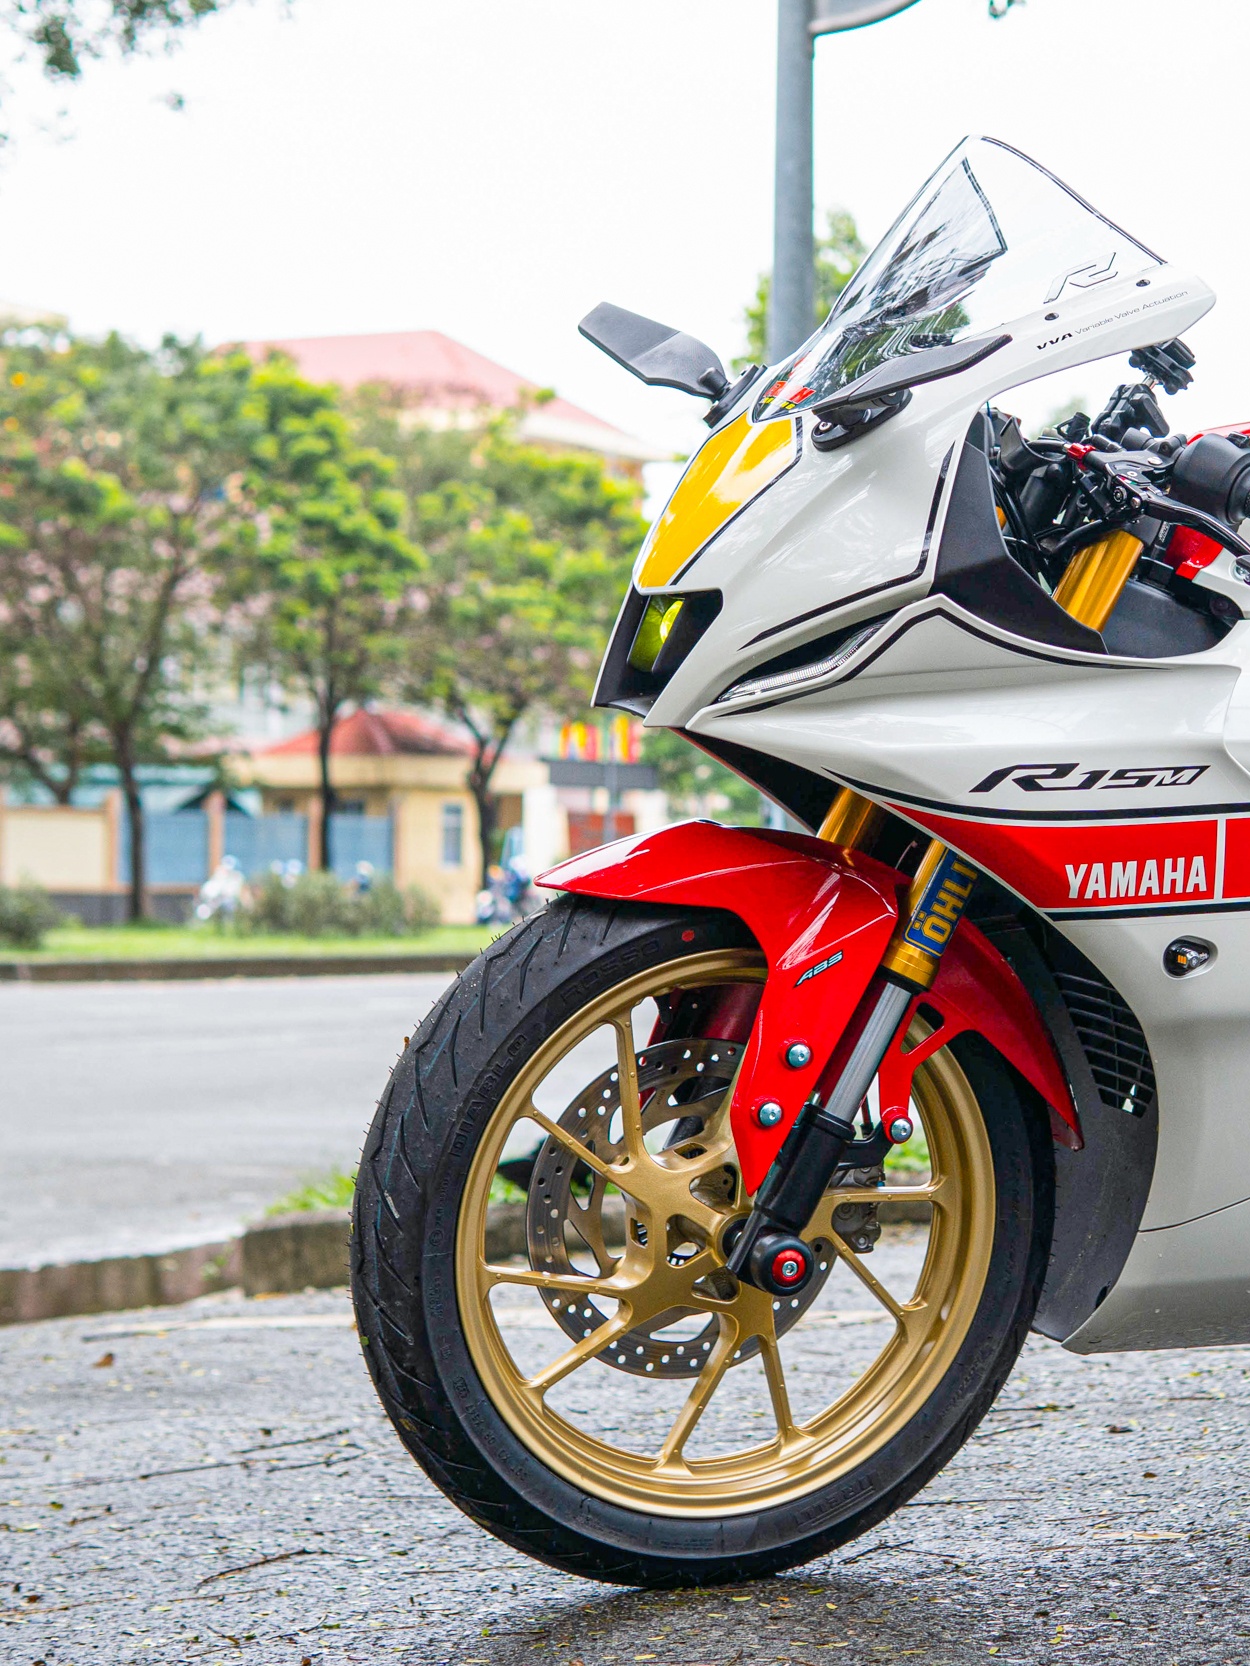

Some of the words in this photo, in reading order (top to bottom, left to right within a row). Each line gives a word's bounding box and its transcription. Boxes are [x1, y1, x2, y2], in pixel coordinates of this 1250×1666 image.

[1036, 332, 1073, 350] VVA
[1075, 316, 1114, 335] Variable
[1114, 306, 1140, 320] Valve
[1142, 291, 1189, 310] Actuation
[968, 762, 1211, 793] R15M
[911, 859, 978, 944] ÖHLI
[1065, 855, 1207, 899] YAMAHA
[560, 938, 661, 1003] ROSSO
[795, 950, 844, 987] ABS
[449, 1033, 528, 1158] DIABLO
